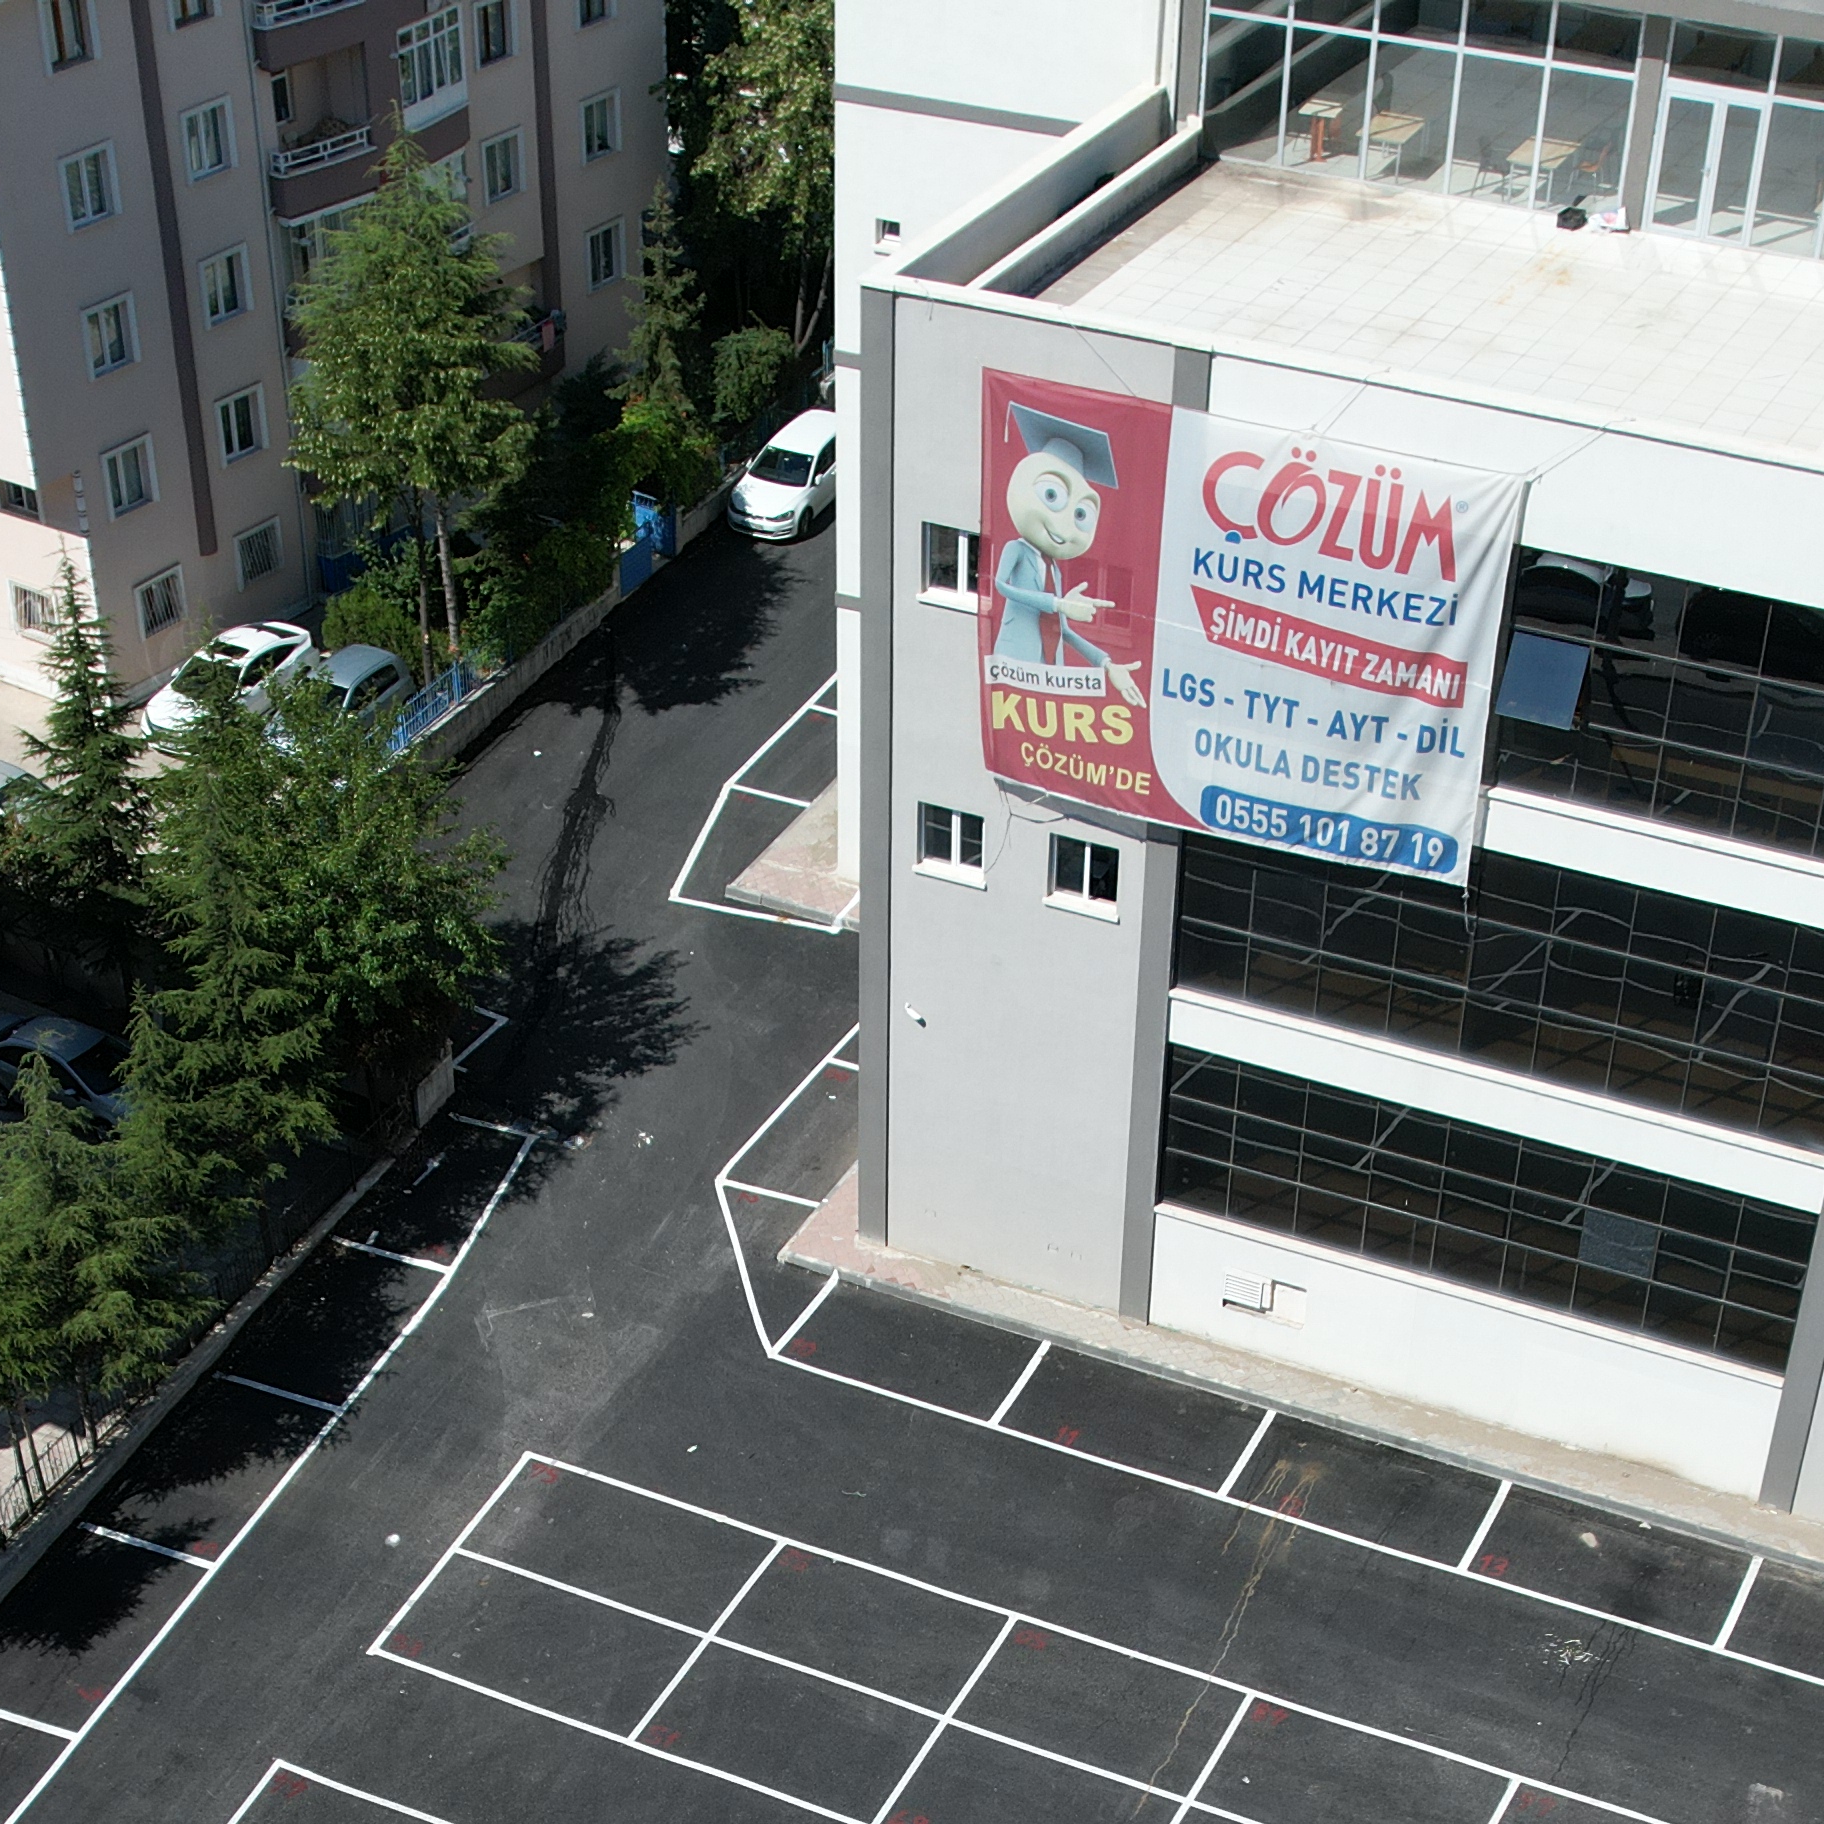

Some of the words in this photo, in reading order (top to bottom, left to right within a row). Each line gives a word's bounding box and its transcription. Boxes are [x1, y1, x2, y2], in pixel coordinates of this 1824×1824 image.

[1203, 447, 1456, 582] ÇÖZÜM
[1193, 547, 1286, 593] KURS
[1297, 570, 1459, 627] MERKEZİ
[990, 662, 1040, 684] çözüm
[1046, 671, 1102, 690] kursta
[1209, 604, 1282, 651] ŞİMDİ
[1284, 629, 1359, 676] KAYIT
[1361, 653, 1461, 700] ZAMANI
[992, 691, 1133, 744] KURS
[1162, 668, 1215, 707] LGS
[1244, 689, 1299, 728] TYT
[1326, 710, 1389, 744] AYT
[1416, 717, 1465, 759] DİL
[1194, 728, 1292, 779] OKULA
[1301, 754, 1423, 800] DESTEK
[1215, 794, 1287, 837] 0555
[1299, 814, 1350, 852] 101
[1360, 827, 1400, 858] 87
[1411, 832, 1443, 867] 19
